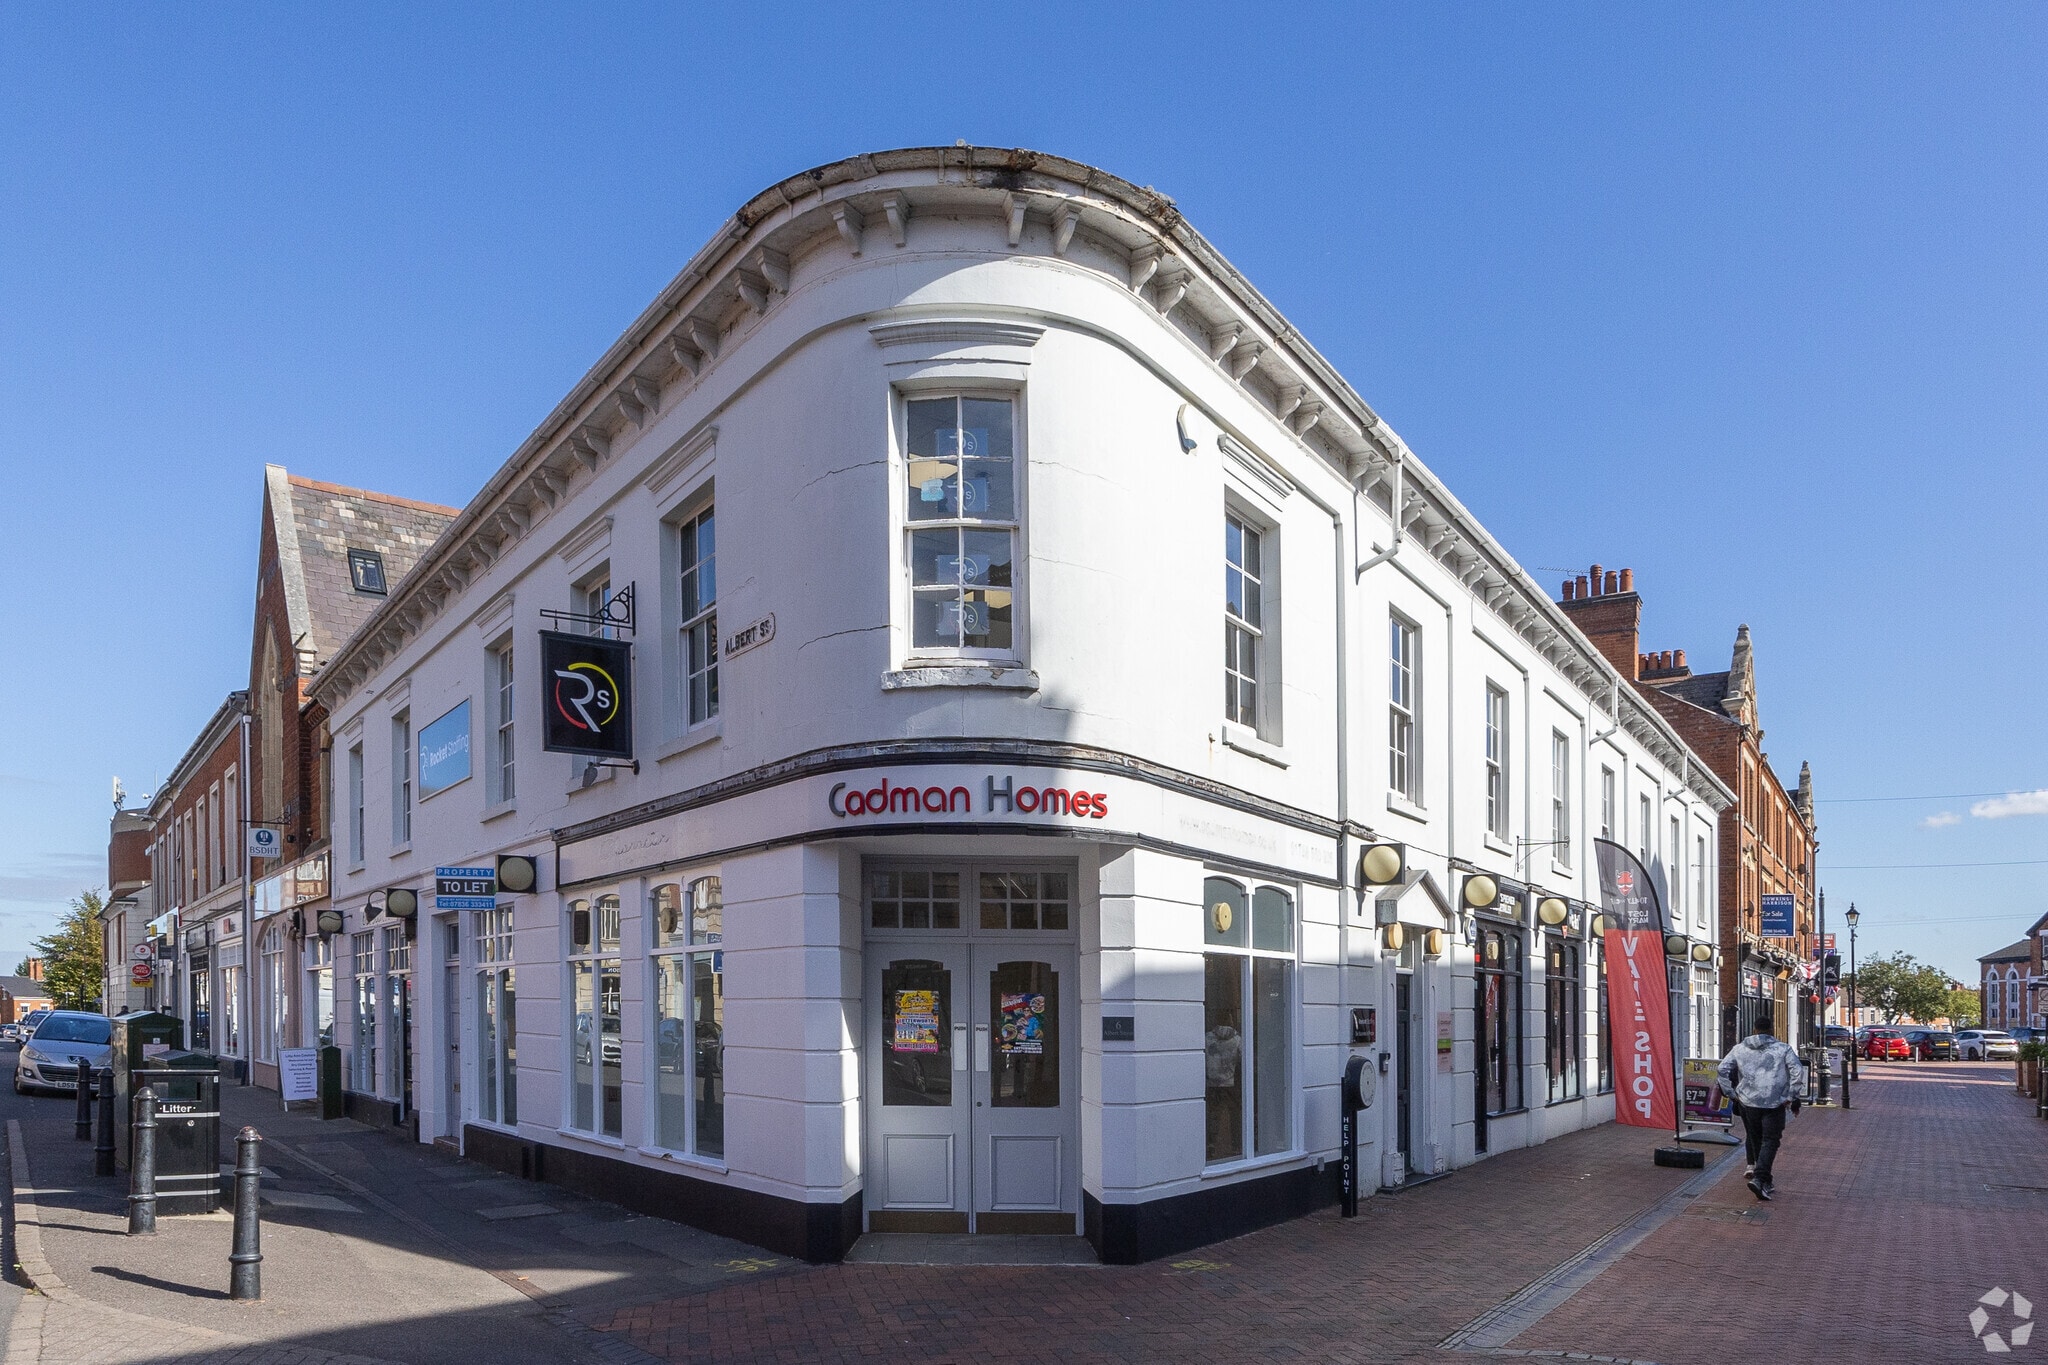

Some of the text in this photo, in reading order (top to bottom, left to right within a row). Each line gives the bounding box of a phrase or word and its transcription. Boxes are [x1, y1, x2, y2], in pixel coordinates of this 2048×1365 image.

[725, 626, 757, 656] ALBERT
[430, 744, 448, 767] Rocket
[448, 734, 469, 757] Staffing
[828, 775, 1108, 818] Cadman Homes
[437, 868, 492, 876] PROPERTY
[443, 881, 488, 893] TO LET
[1115, 1021, 1122, 1030] 6
[162, 1104, 192, 1113] Litter
